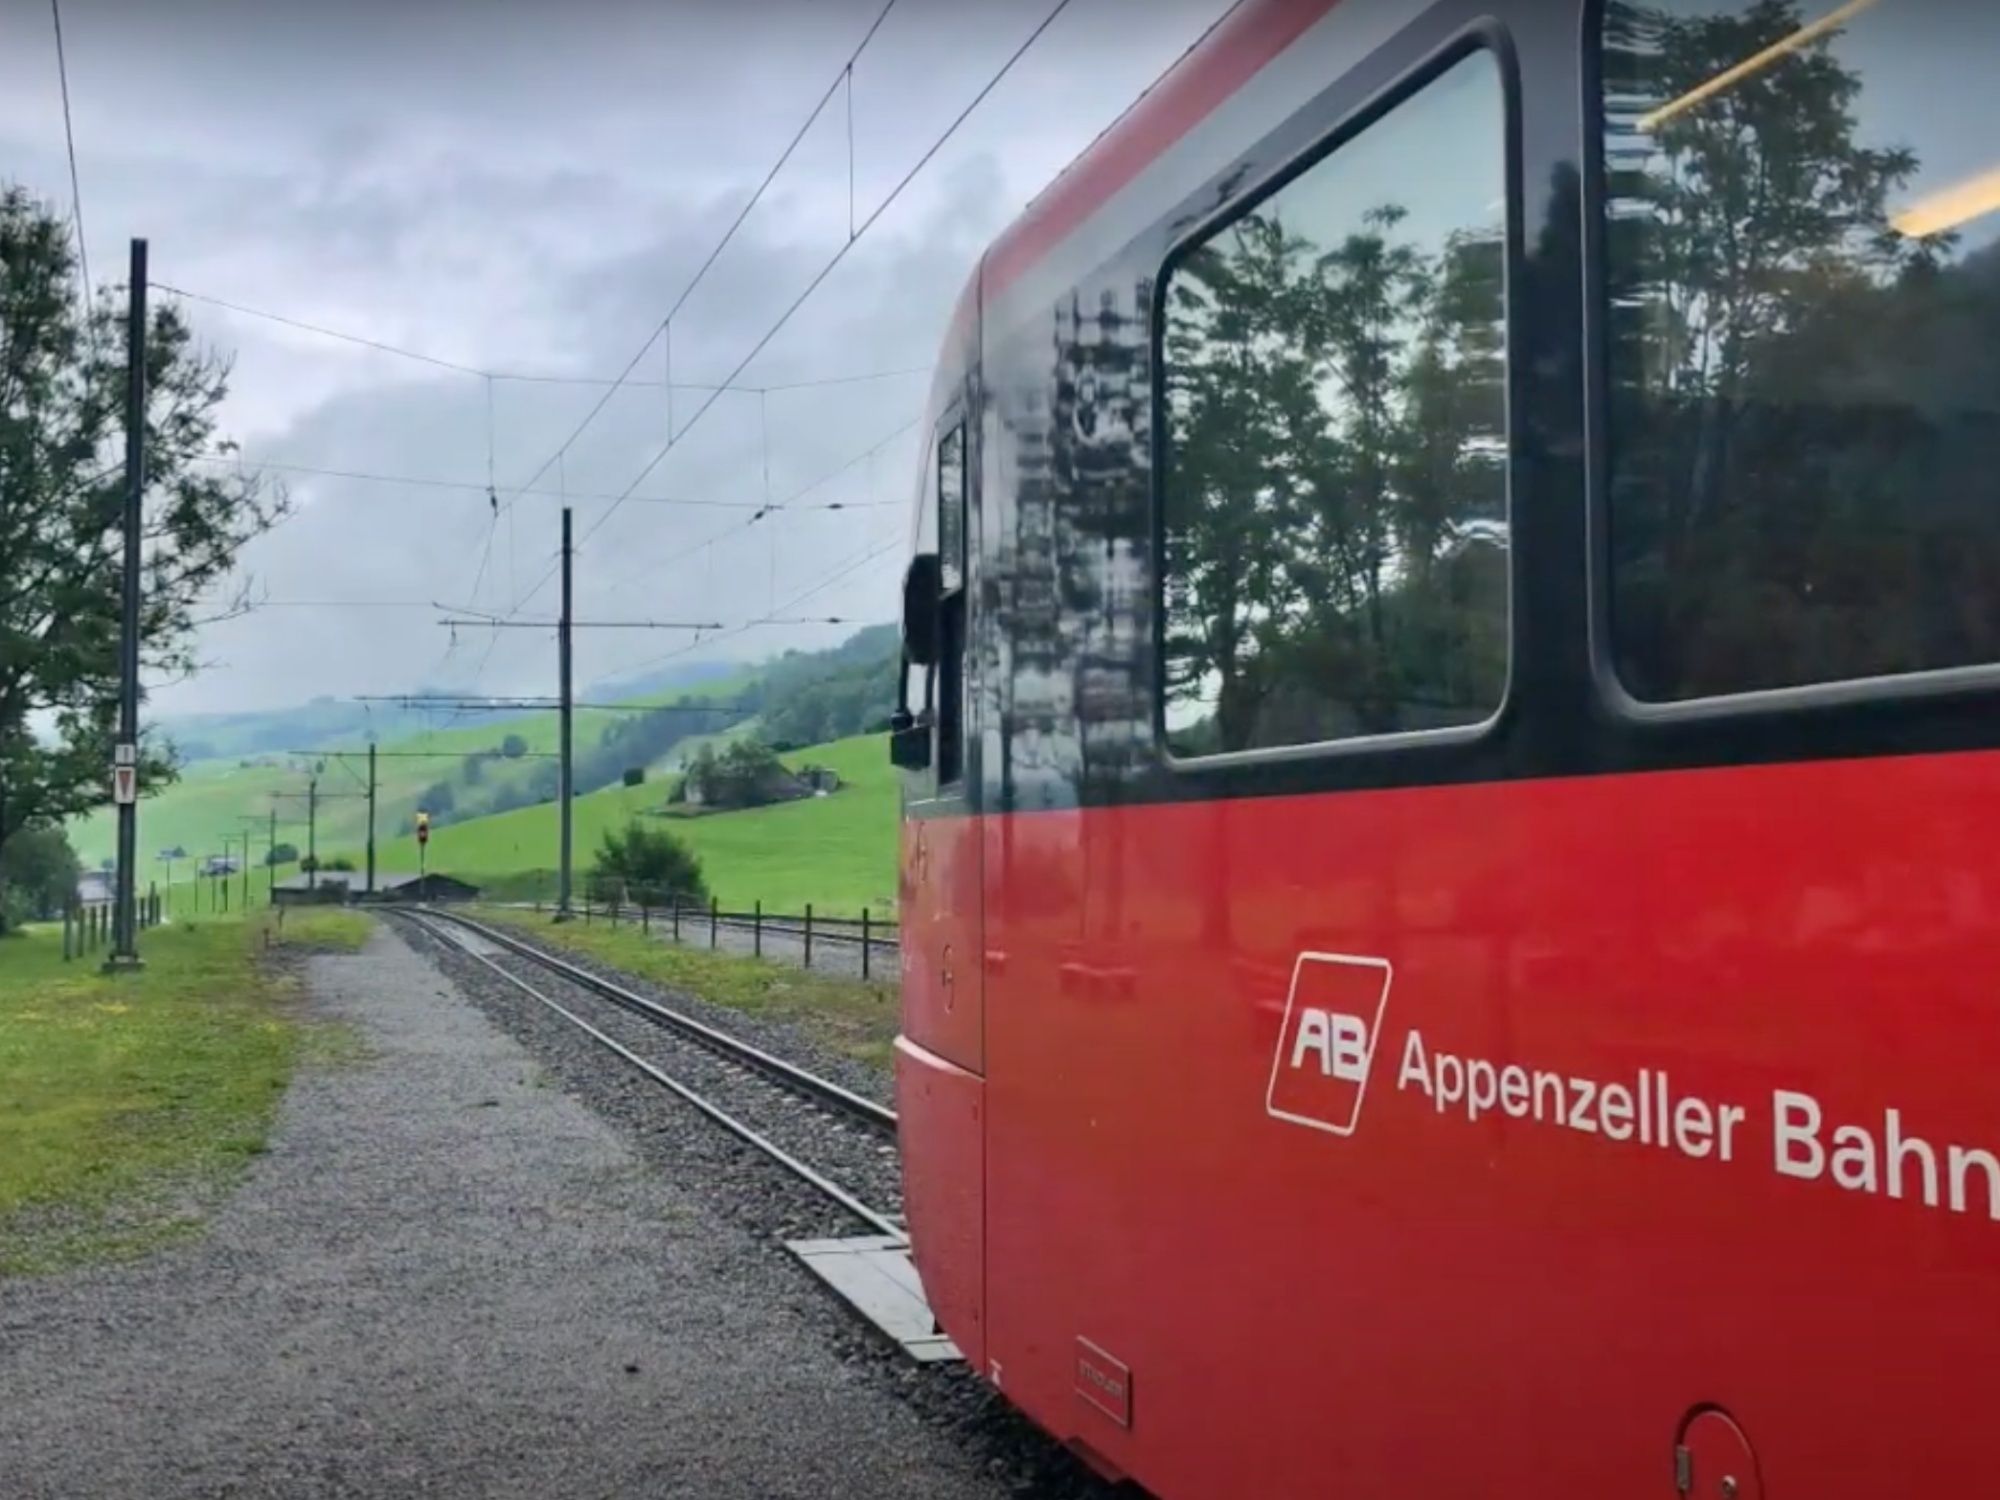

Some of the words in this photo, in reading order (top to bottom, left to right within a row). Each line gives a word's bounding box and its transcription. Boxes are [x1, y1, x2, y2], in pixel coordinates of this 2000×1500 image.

[1291, 1009, 1370, 1082] AB
[1398, 1030, 1744, 1161] Appenzeller
[1774, 1089, 2000, 1221] Bahn
